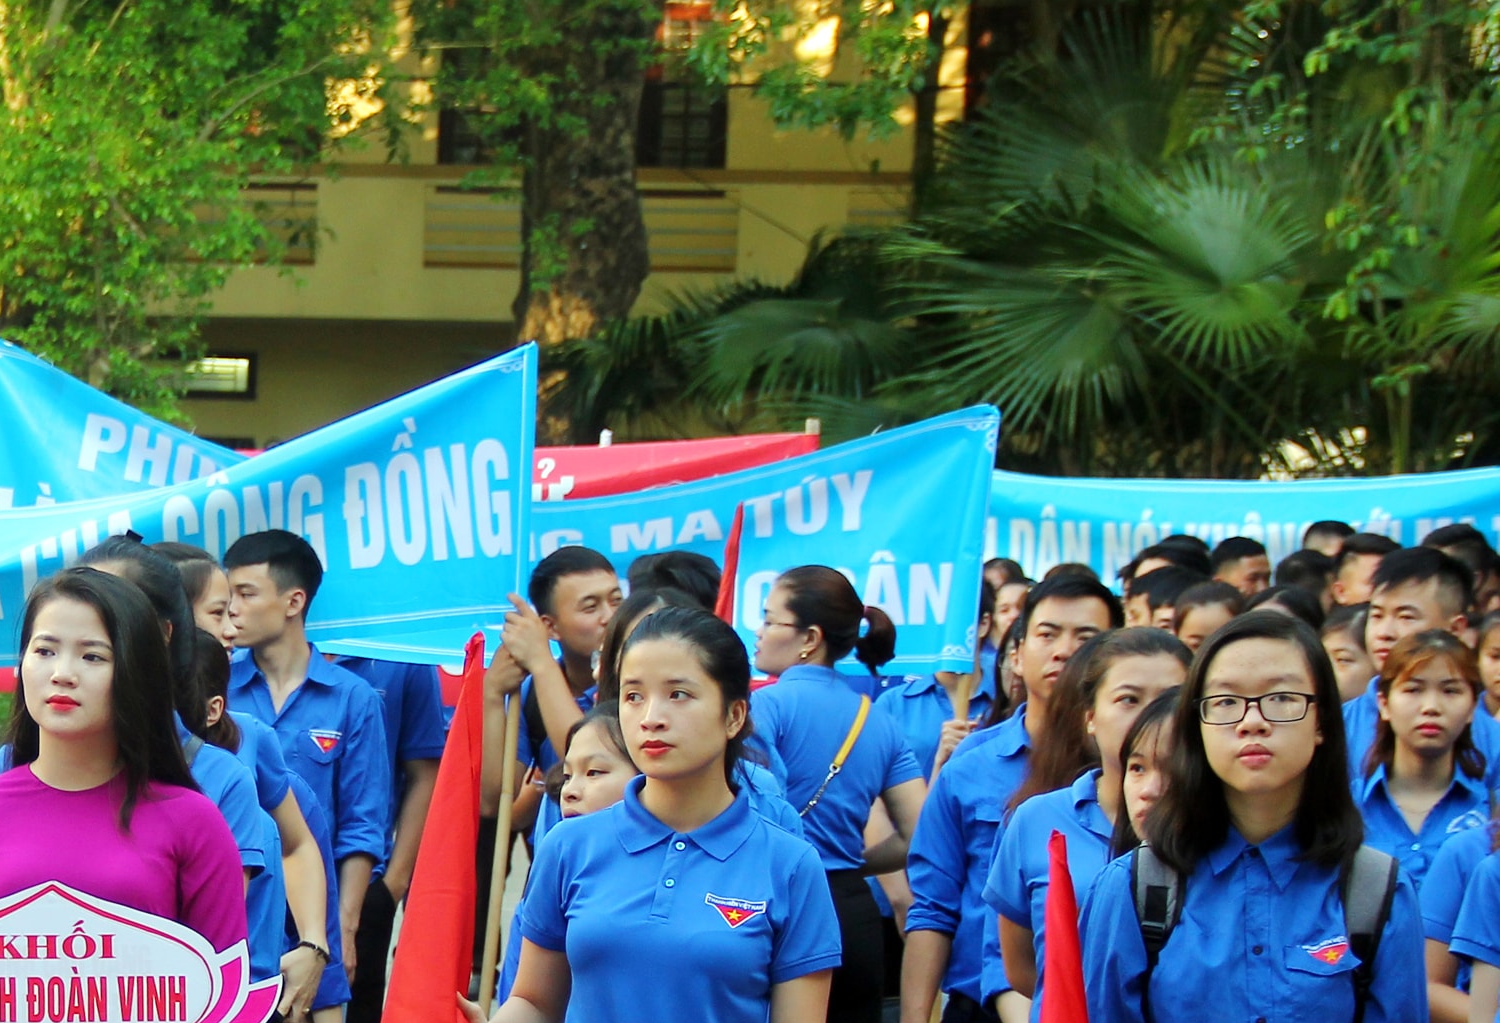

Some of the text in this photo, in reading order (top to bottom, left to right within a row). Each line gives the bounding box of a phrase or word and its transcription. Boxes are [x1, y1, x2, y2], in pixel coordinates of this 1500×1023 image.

[343, 416, 513, 570] ĐỒNG
[610, 509, 723, 553] MA
[743, 470, 874, 538] TÚY
[834, 550, 954, 626] ÂN
[26, 965, 108, 1023] ĐOÀN
[116, 974, 188, 1022] VINH
